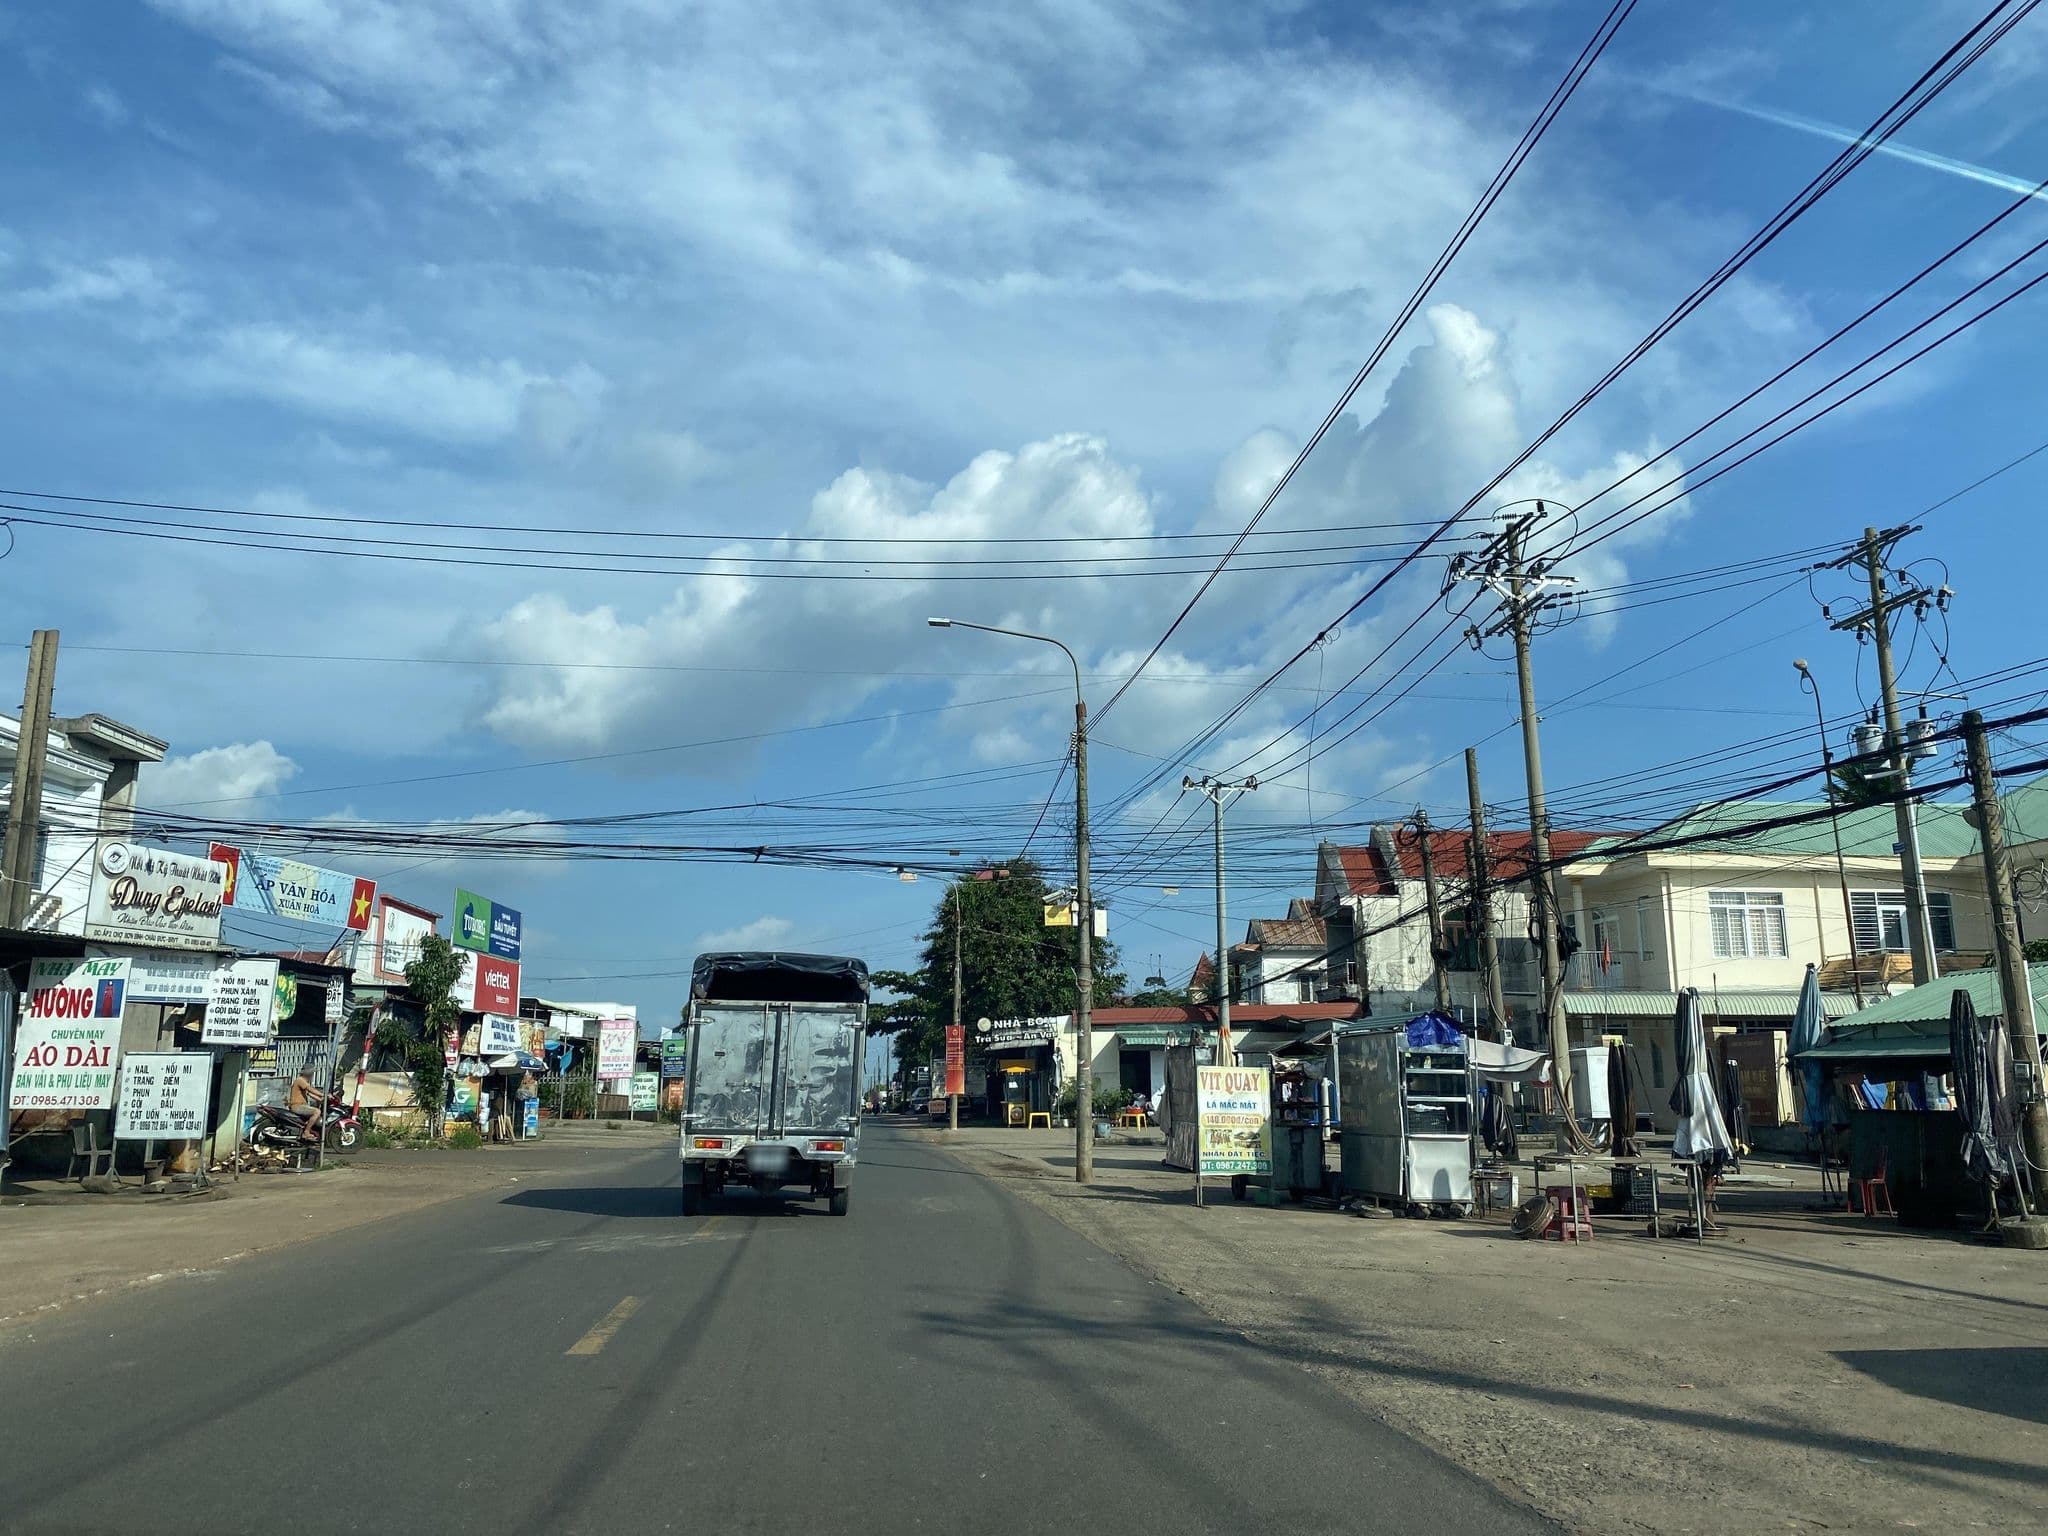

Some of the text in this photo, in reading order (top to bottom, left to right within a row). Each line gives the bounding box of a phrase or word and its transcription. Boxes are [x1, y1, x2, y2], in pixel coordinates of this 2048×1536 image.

[110, 876, 222, 919] Dung Eyelash
[463, 914, 486, 936] TUBORG
[82, 961, 124, 976] MAY
[485, 969, 510, 990] viettel
[993, 1016, 1021, 1029] NHÀ
[87, 1030, 105, 1040] MAY
[22, 1040, 111, 1067] ÁO DÀI
[134, 1065, 149, 1074] NAIL
[94, 1074, 111, 1088] MAY
[133, 1076, 155, 1085] TRANG
[1200, 1072, 1260, 1095] VỊT QUAY
[132, 1088, 150, 1097] PHUN
